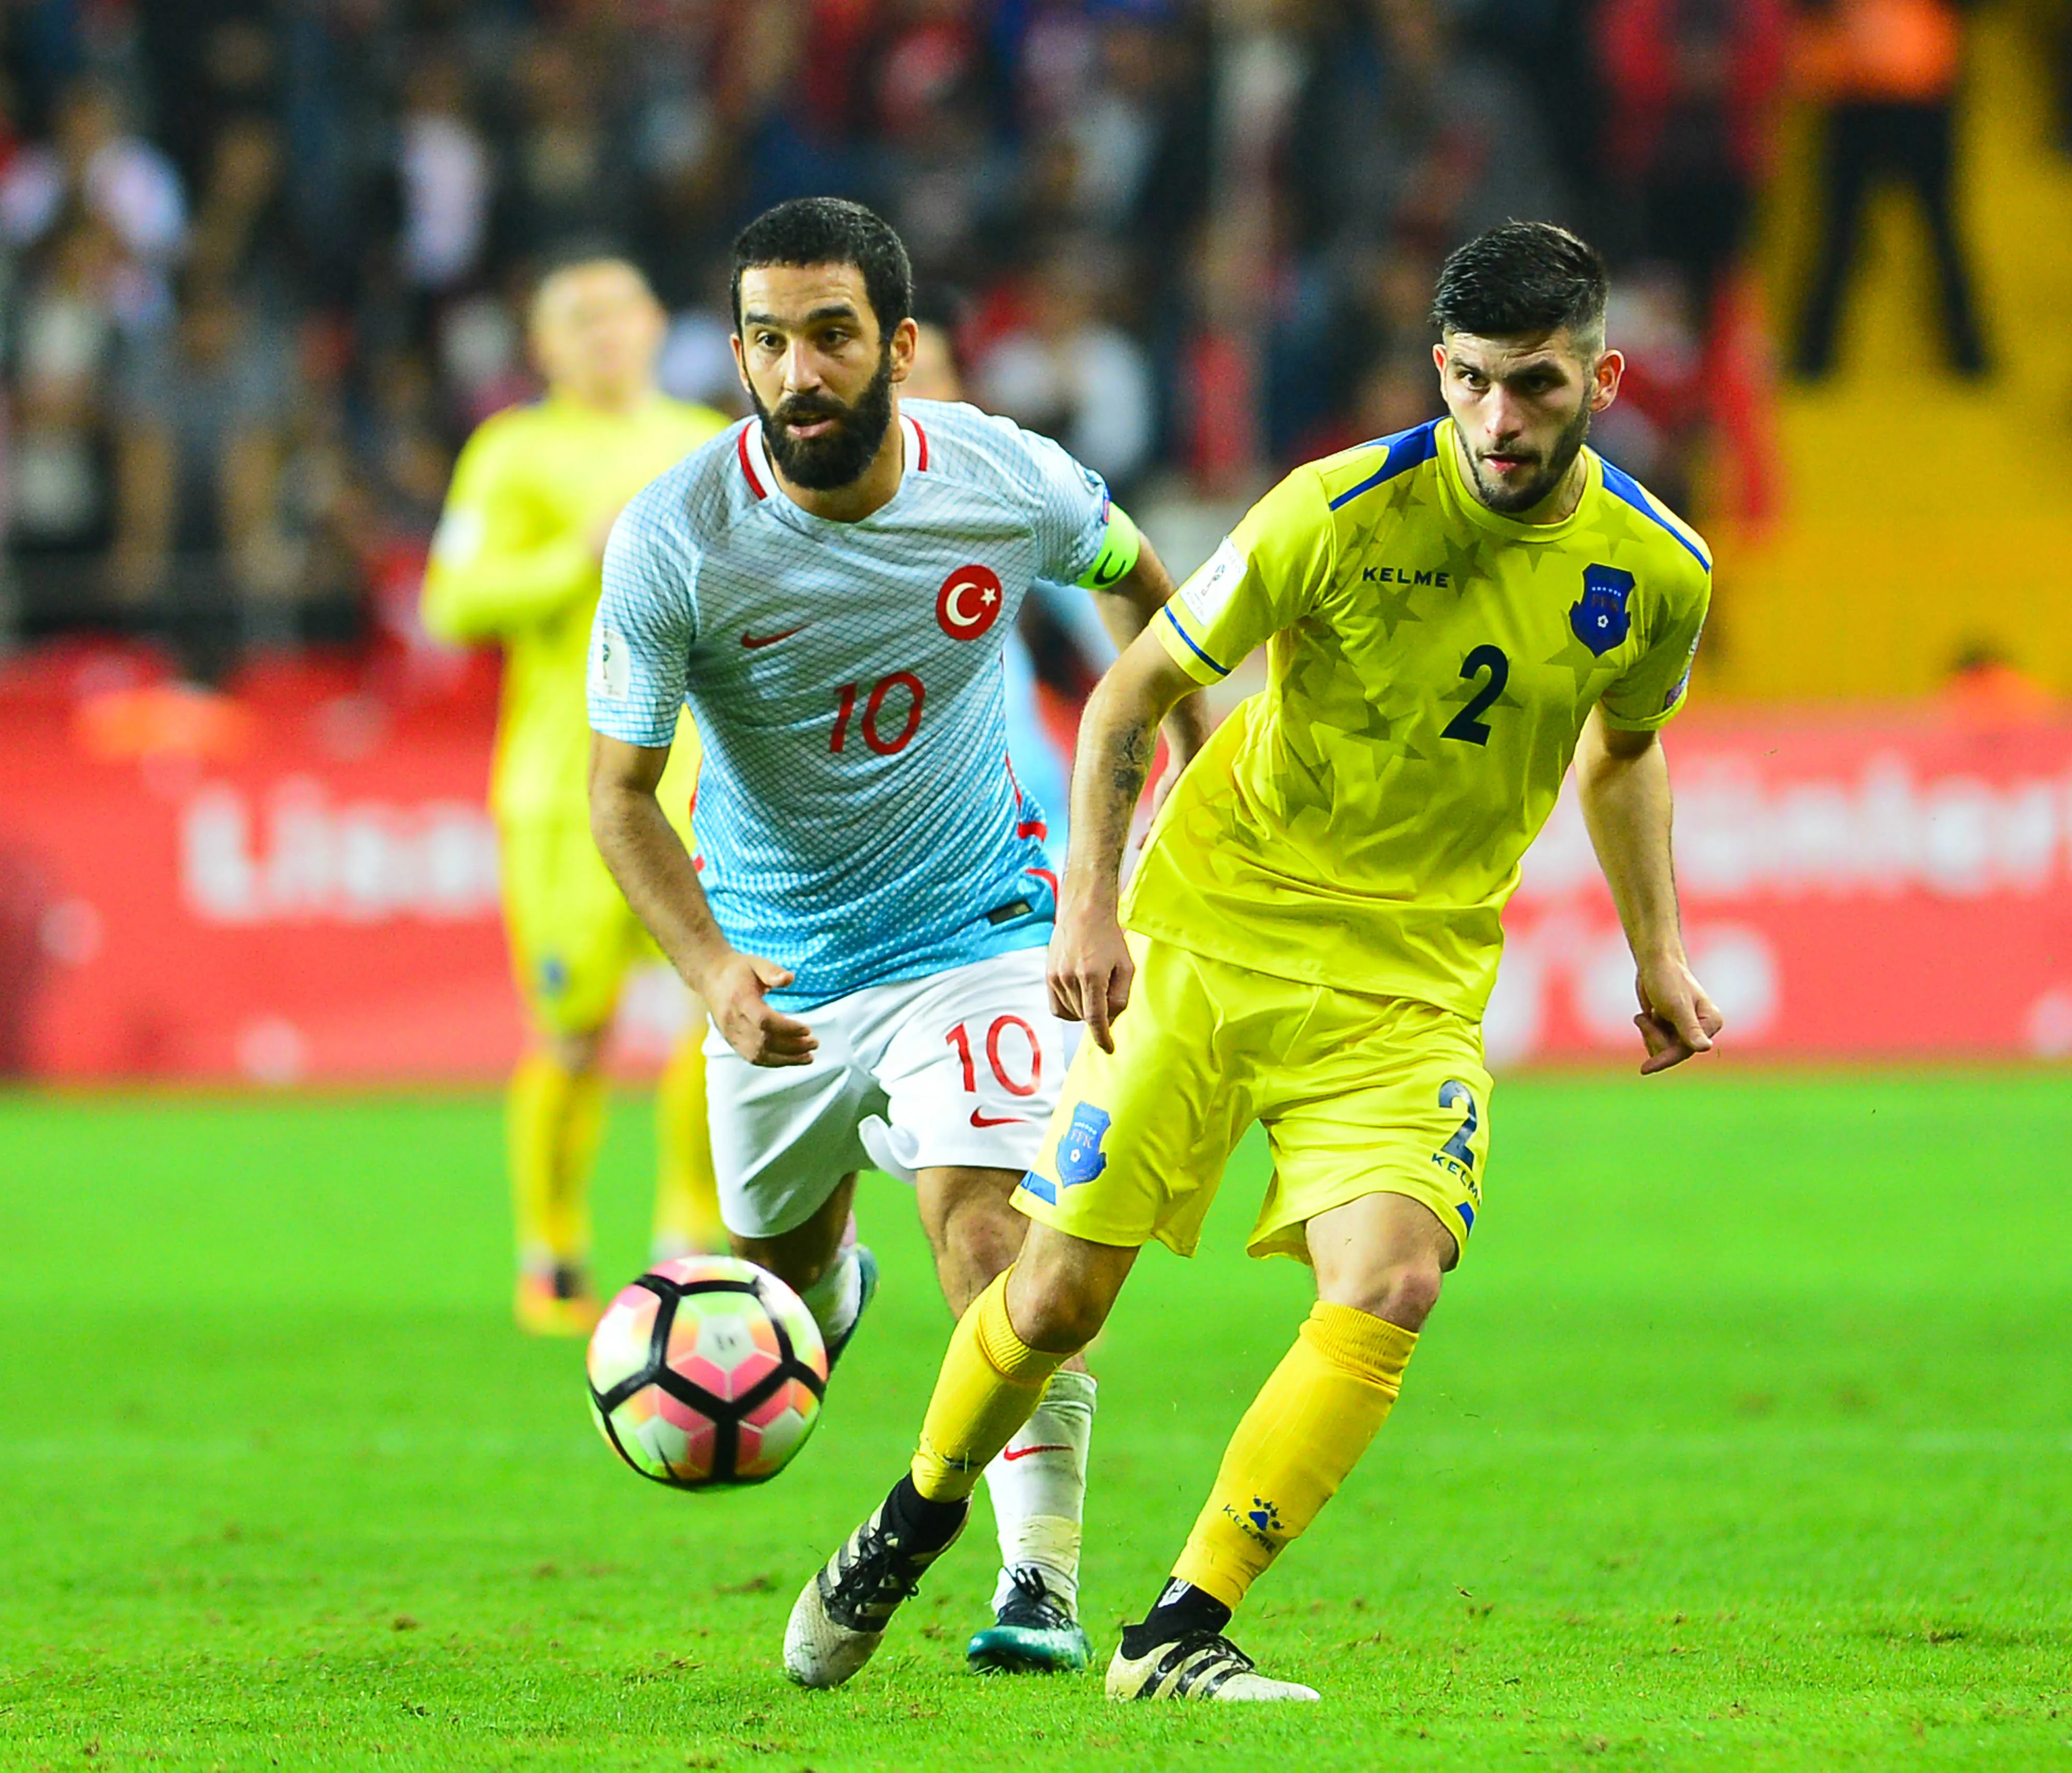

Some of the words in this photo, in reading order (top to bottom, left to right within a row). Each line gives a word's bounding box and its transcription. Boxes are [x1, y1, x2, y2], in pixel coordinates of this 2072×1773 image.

[1362, 566, 1449, 589] KELME
[830, 670, 926, 755] 10
[1440, 644, 1509, 747] 2
[945, 1014, 1041, 1097] 10
[1438, 1079, 1477, 1171] 2
[1431, 1152, 1480, 1206] KELM
